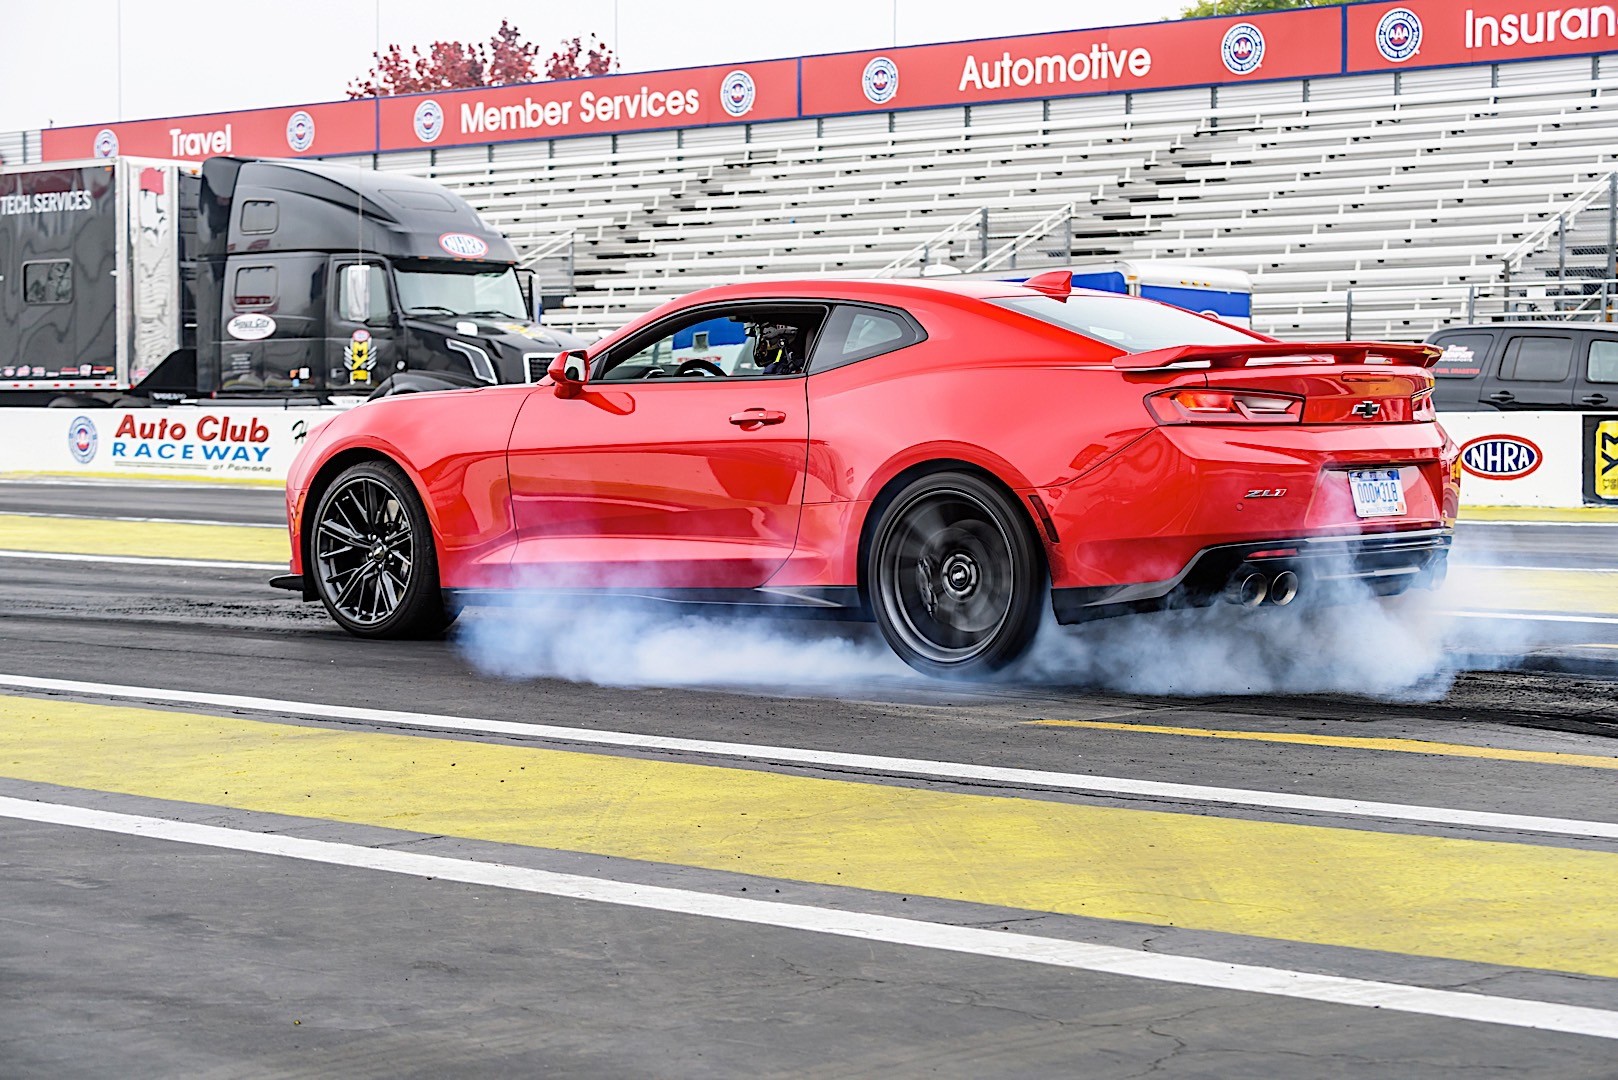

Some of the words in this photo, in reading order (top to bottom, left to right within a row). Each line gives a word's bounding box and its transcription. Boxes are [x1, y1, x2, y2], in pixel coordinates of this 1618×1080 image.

[1389, 26, 1409, 40] AAA
[1465, 5, 1618, 49] Insuran
[958, 43, 1151, 91] Automotive
[461, 99, 572, 133] Member
[579, 87, 700, 123] Services
[169, 124, 232, 157] Travel
[115, 414, 186, 441] Auto
[196, 415, 270, 443] Club
[112, 442, 270, 462] RACEWAY
[1470, 442, 1530, 472] NHRA
